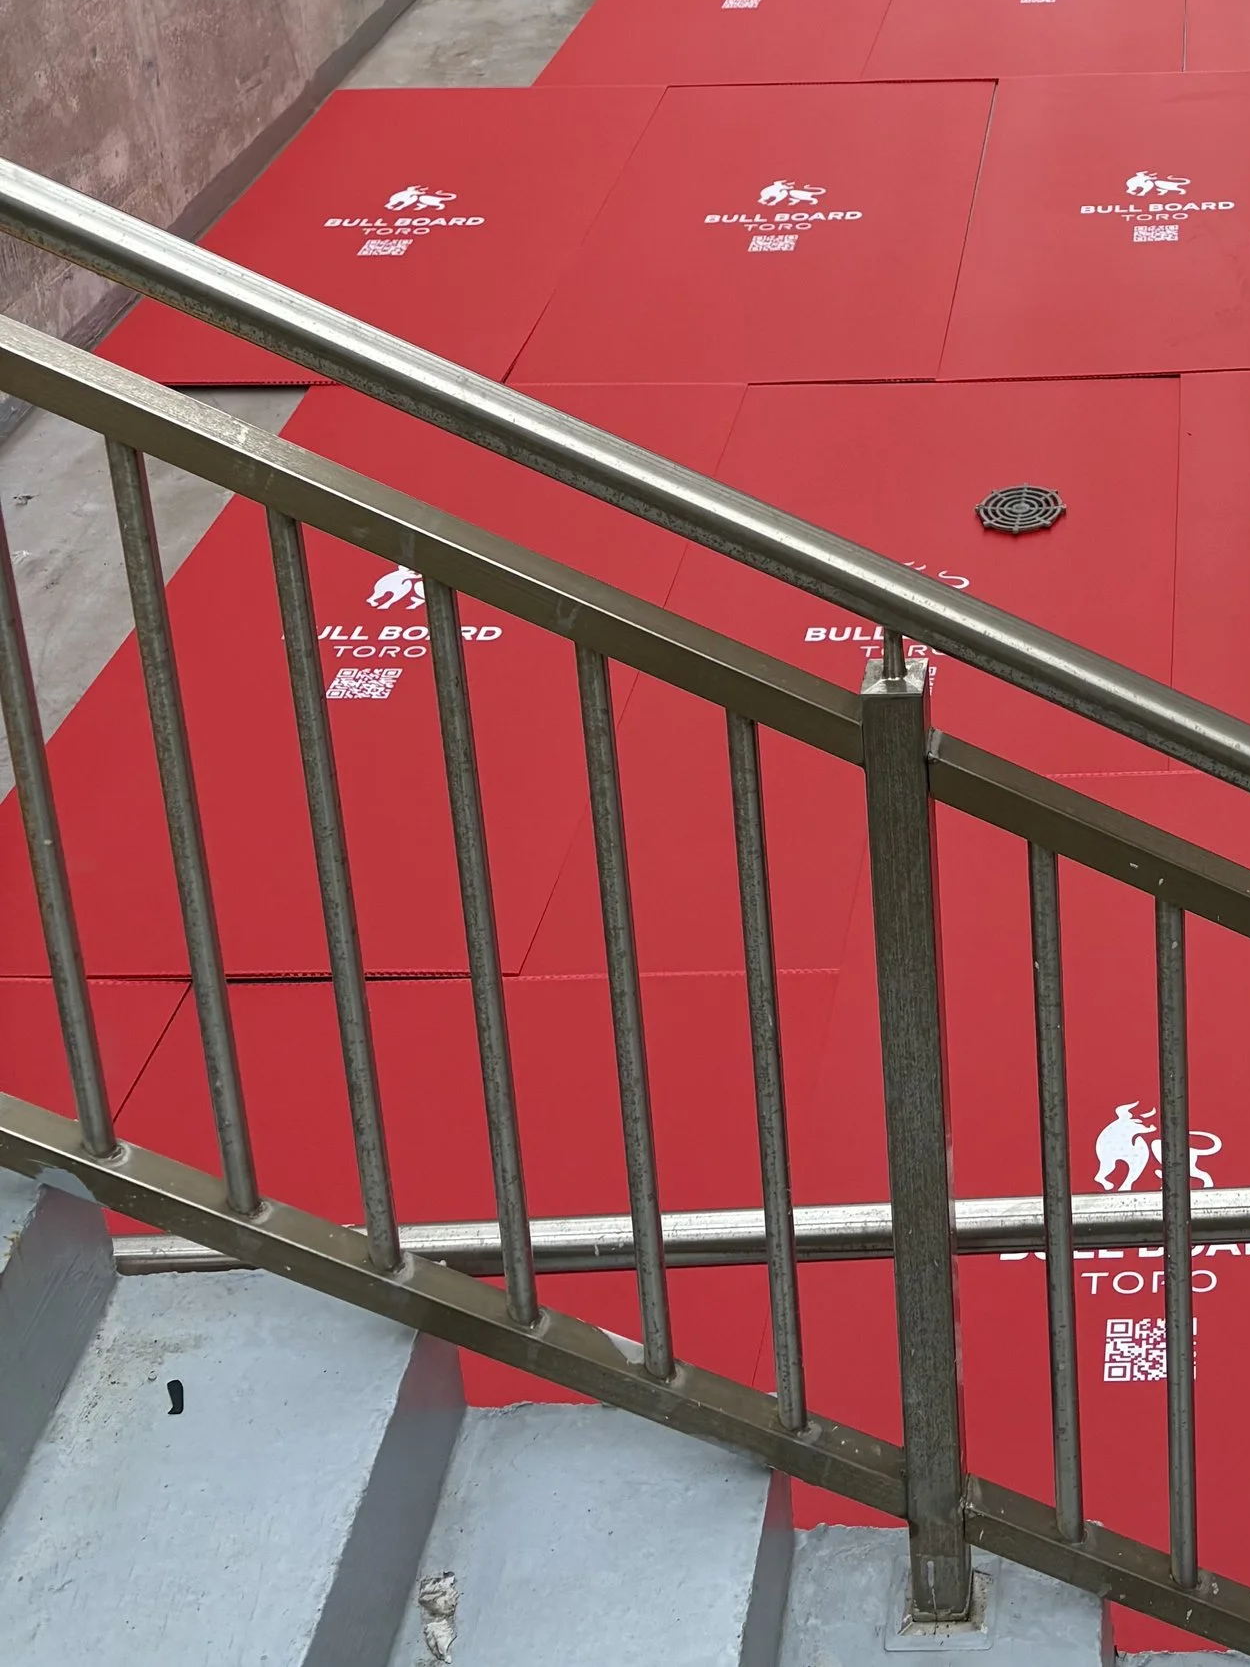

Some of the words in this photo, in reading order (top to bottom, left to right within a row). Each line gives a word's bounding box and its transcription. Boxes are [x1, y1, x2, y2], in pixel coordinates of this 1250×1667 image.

[1080, 204, 1142, 214] BULL
[1148, 201, 1235, 212] BOARD
[324, 218, 387, 227] BULL
[393, 217, 485, 226] BOARD
[704, 214, 767, 223] BULL
[774, 211, 863, 222] BOARD
[1121, 212, 1189, 221] TORO
[362, 227, 431, 235] TORO
[744, 222, 812, 231] TORO
[282, 626, 369, 641] ULL
[378, 626, 503, 641] BORD
[333, 645, 427, 658] TORO
